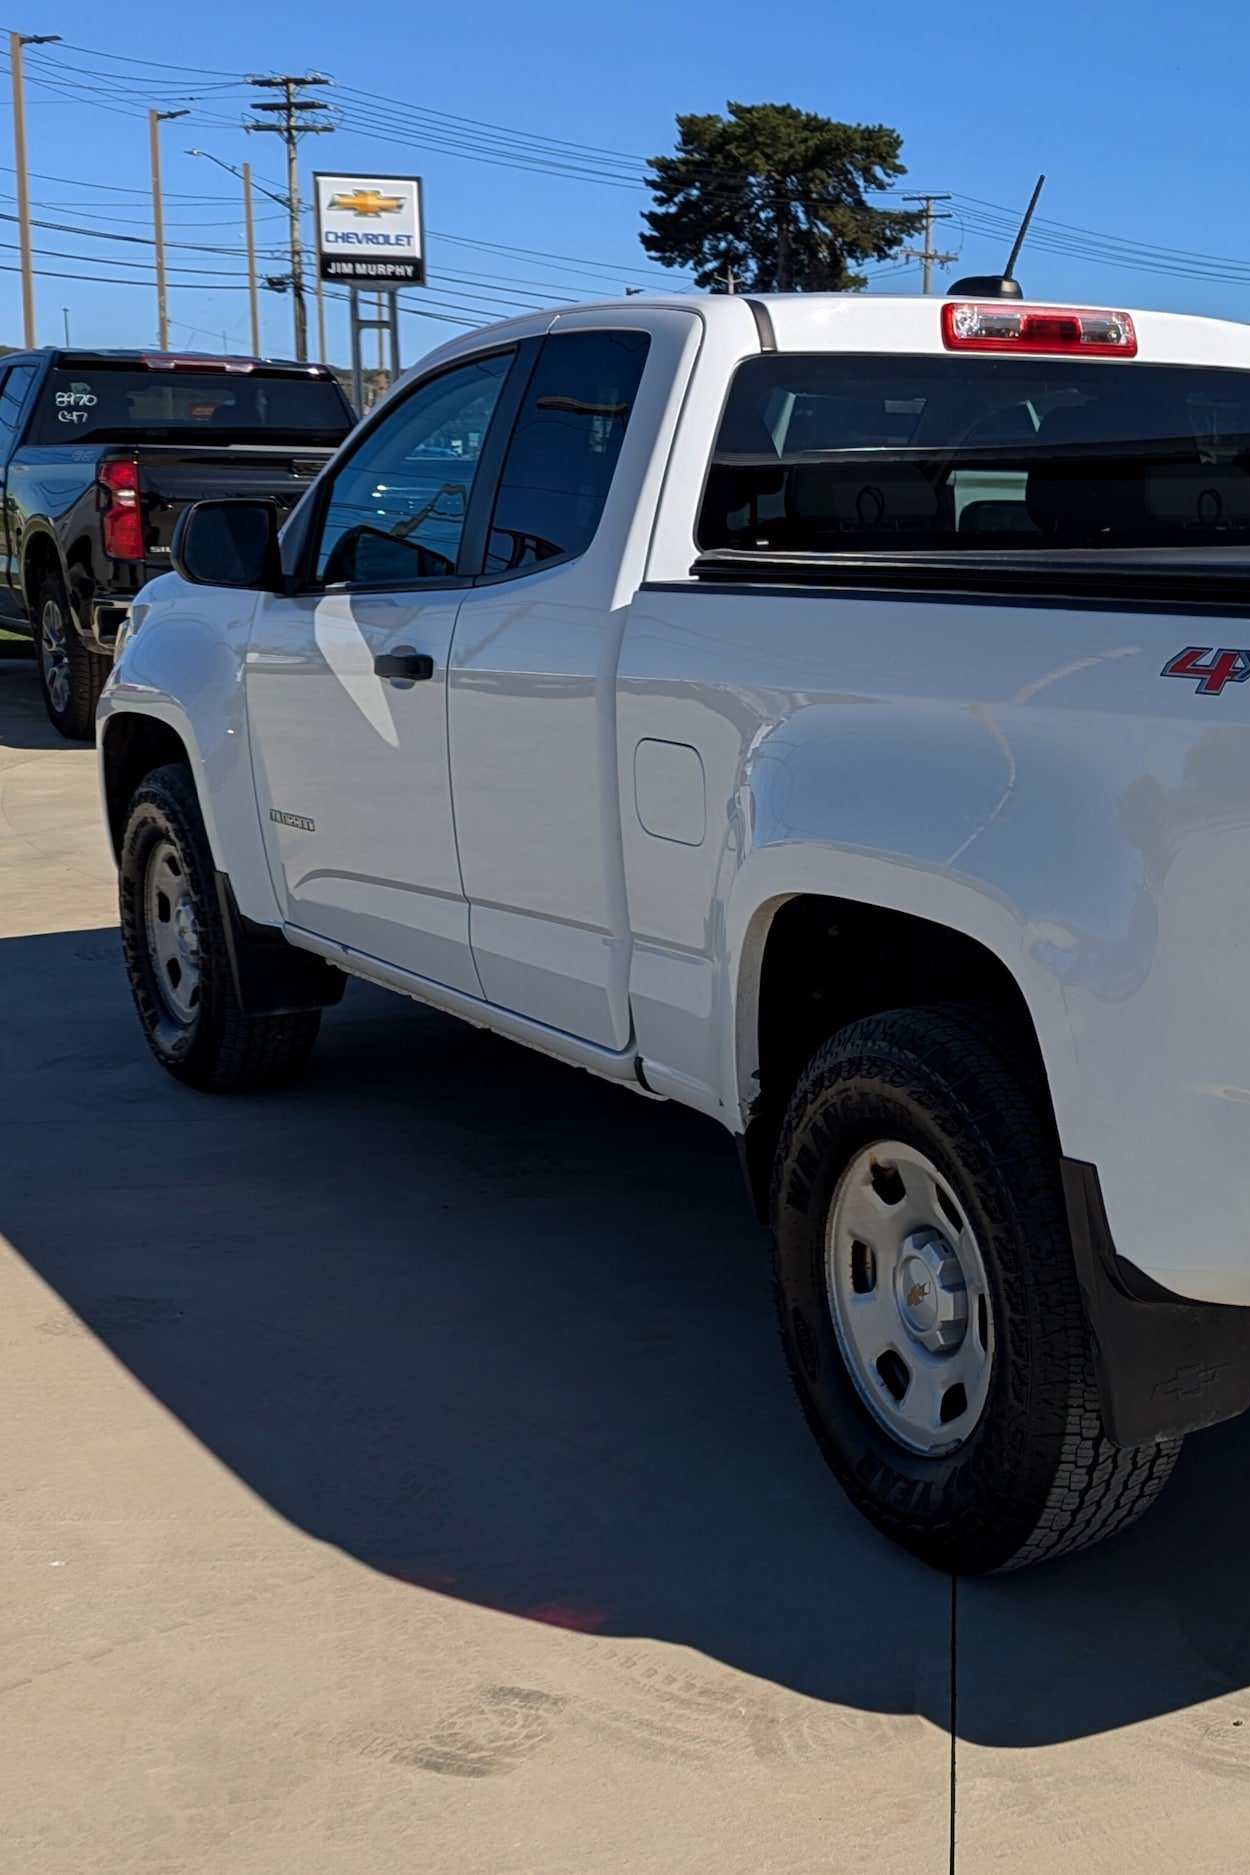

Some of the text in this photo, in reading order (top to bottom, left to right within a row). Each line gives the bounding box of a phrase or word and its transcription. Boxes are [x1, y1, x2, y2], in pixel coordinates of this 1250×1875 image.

[324, 230, 414, 247] CHEVROLET
[327, 261, 415, 277] JIM MURPHY
[55, 391, 98, 407] 8970
